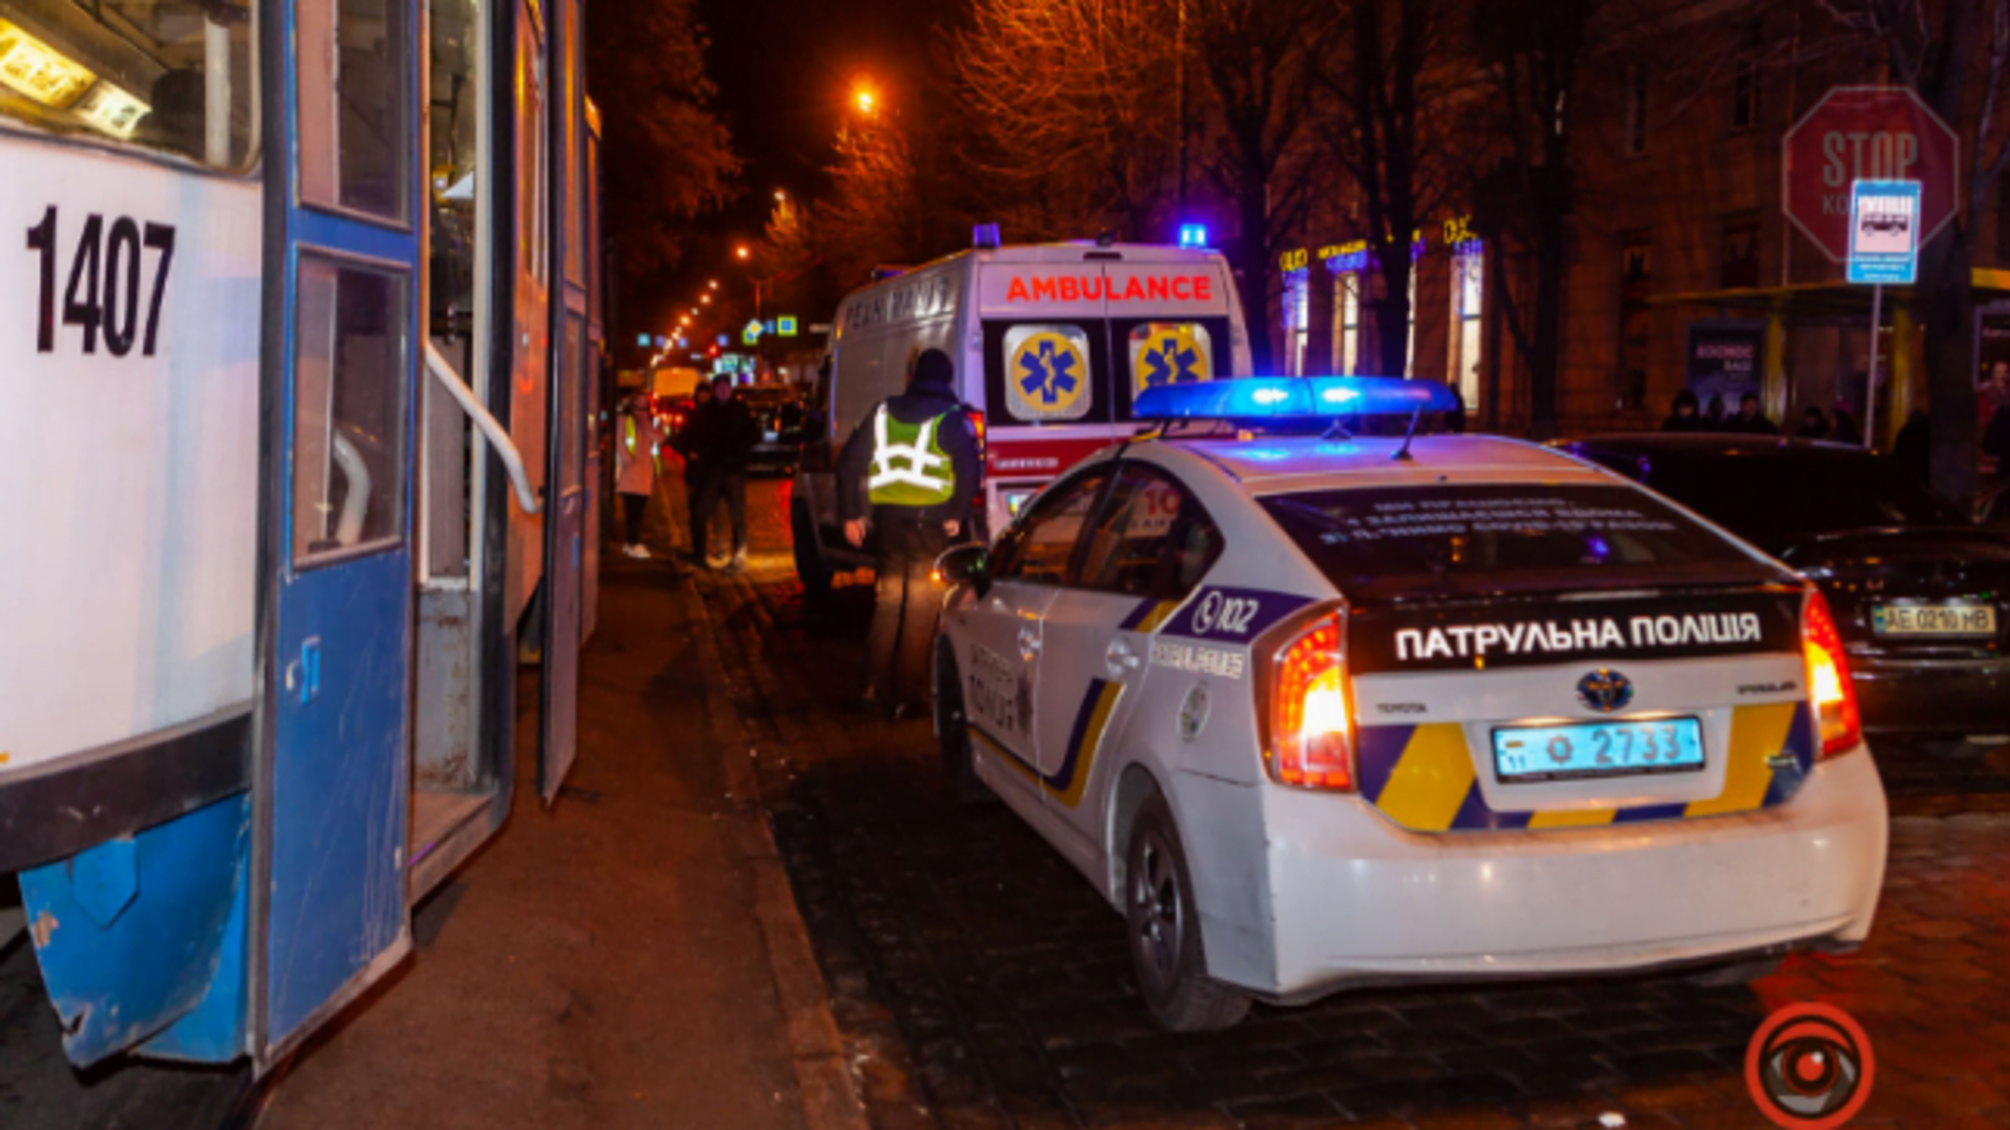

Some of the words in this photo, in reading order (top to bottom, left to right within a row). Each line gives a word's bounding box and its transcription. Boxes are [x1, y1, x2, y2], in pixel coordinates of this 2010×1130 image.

[26, 205, 176, 358] 1407
[1006, 275, 1212, 303] AMBULANCE
[1216, 598, 1259, 633] 102
[1395, 617, 1626, 661] ПАТРУЛЬНА
[1630, 612, 1762, 646] ПОЛІЦІЯ
[1376, 702, 1429, 715] TOYOTA
[1592, 723, 1682, 765] 2733
